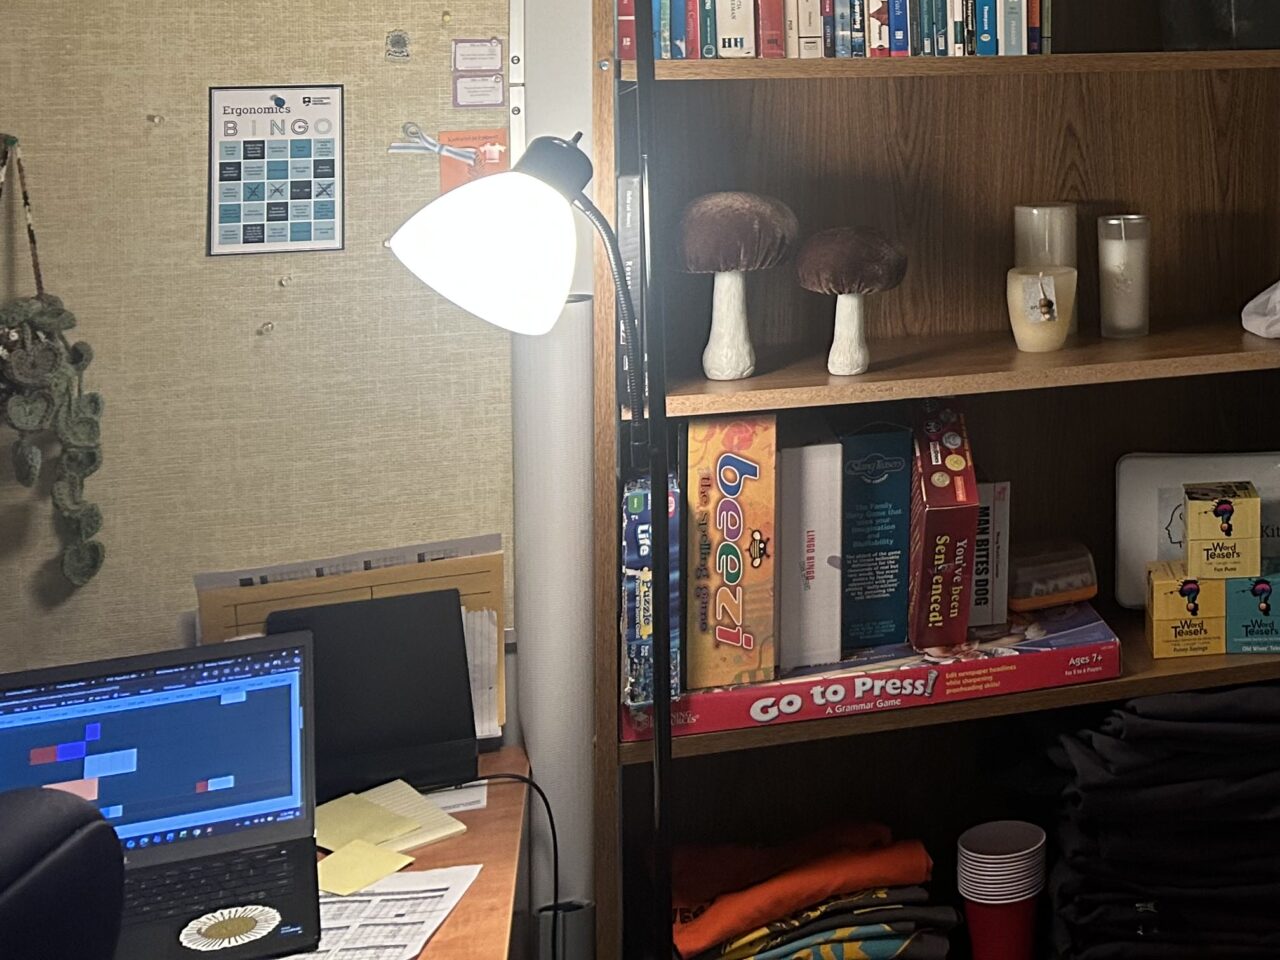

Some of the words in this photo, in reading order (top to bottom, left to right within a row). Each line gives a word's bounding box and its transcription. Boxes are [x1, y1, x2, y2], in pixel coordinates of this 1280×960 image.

[222, 105, 291, 117] Ergonomics
[223, 118, 333, 136] BINGO
[698, 475, 711, 505] the
[975, 505, 991, 537] MAN
[636, 524, 653, 557] Life
[805, 530, 816, 553] LINGO
[1260, 525, 1280, 539] Kit
[695, 512, 711, 580] spelling
[715, 452, 760, 651] beezi
[1203, 548, 1241, 561] Teasers
[1212, 542, 1237, 552] Word
[953, 538, 968, 583] You've
[974, 540, 990, 576] BITES
[805, 556, 815, 581] BINGO
[949, 585, 963, 618] been
[974, 578, 990, 607] DOG
[695, 585, 710, 633] game
[1171, 625, 1208, 639] Teasers
[1180, 620, 1204, 630] Word
[1241, 624, 1279, 638] Teasers
[1250, 619, 1275, 629] Word
[1068, 655, 1090, 667] Ages
[1092, 653, 1103, 662] 7+
[945, 670, 958, 680] Edit
[957, 667, 989, 679] newspaper
[989, 664, 1017, 673] headlines
[961, 675, 993, 687] sharpening
[749, 693, 803, 723] Go
[810, 683, 846, 706] to
[853, 669, 939, 701] Press!
[825, 706, 834, 715] A
[834, 701, 875, 714] Grammar
[875, 698, 902, 708] Game
